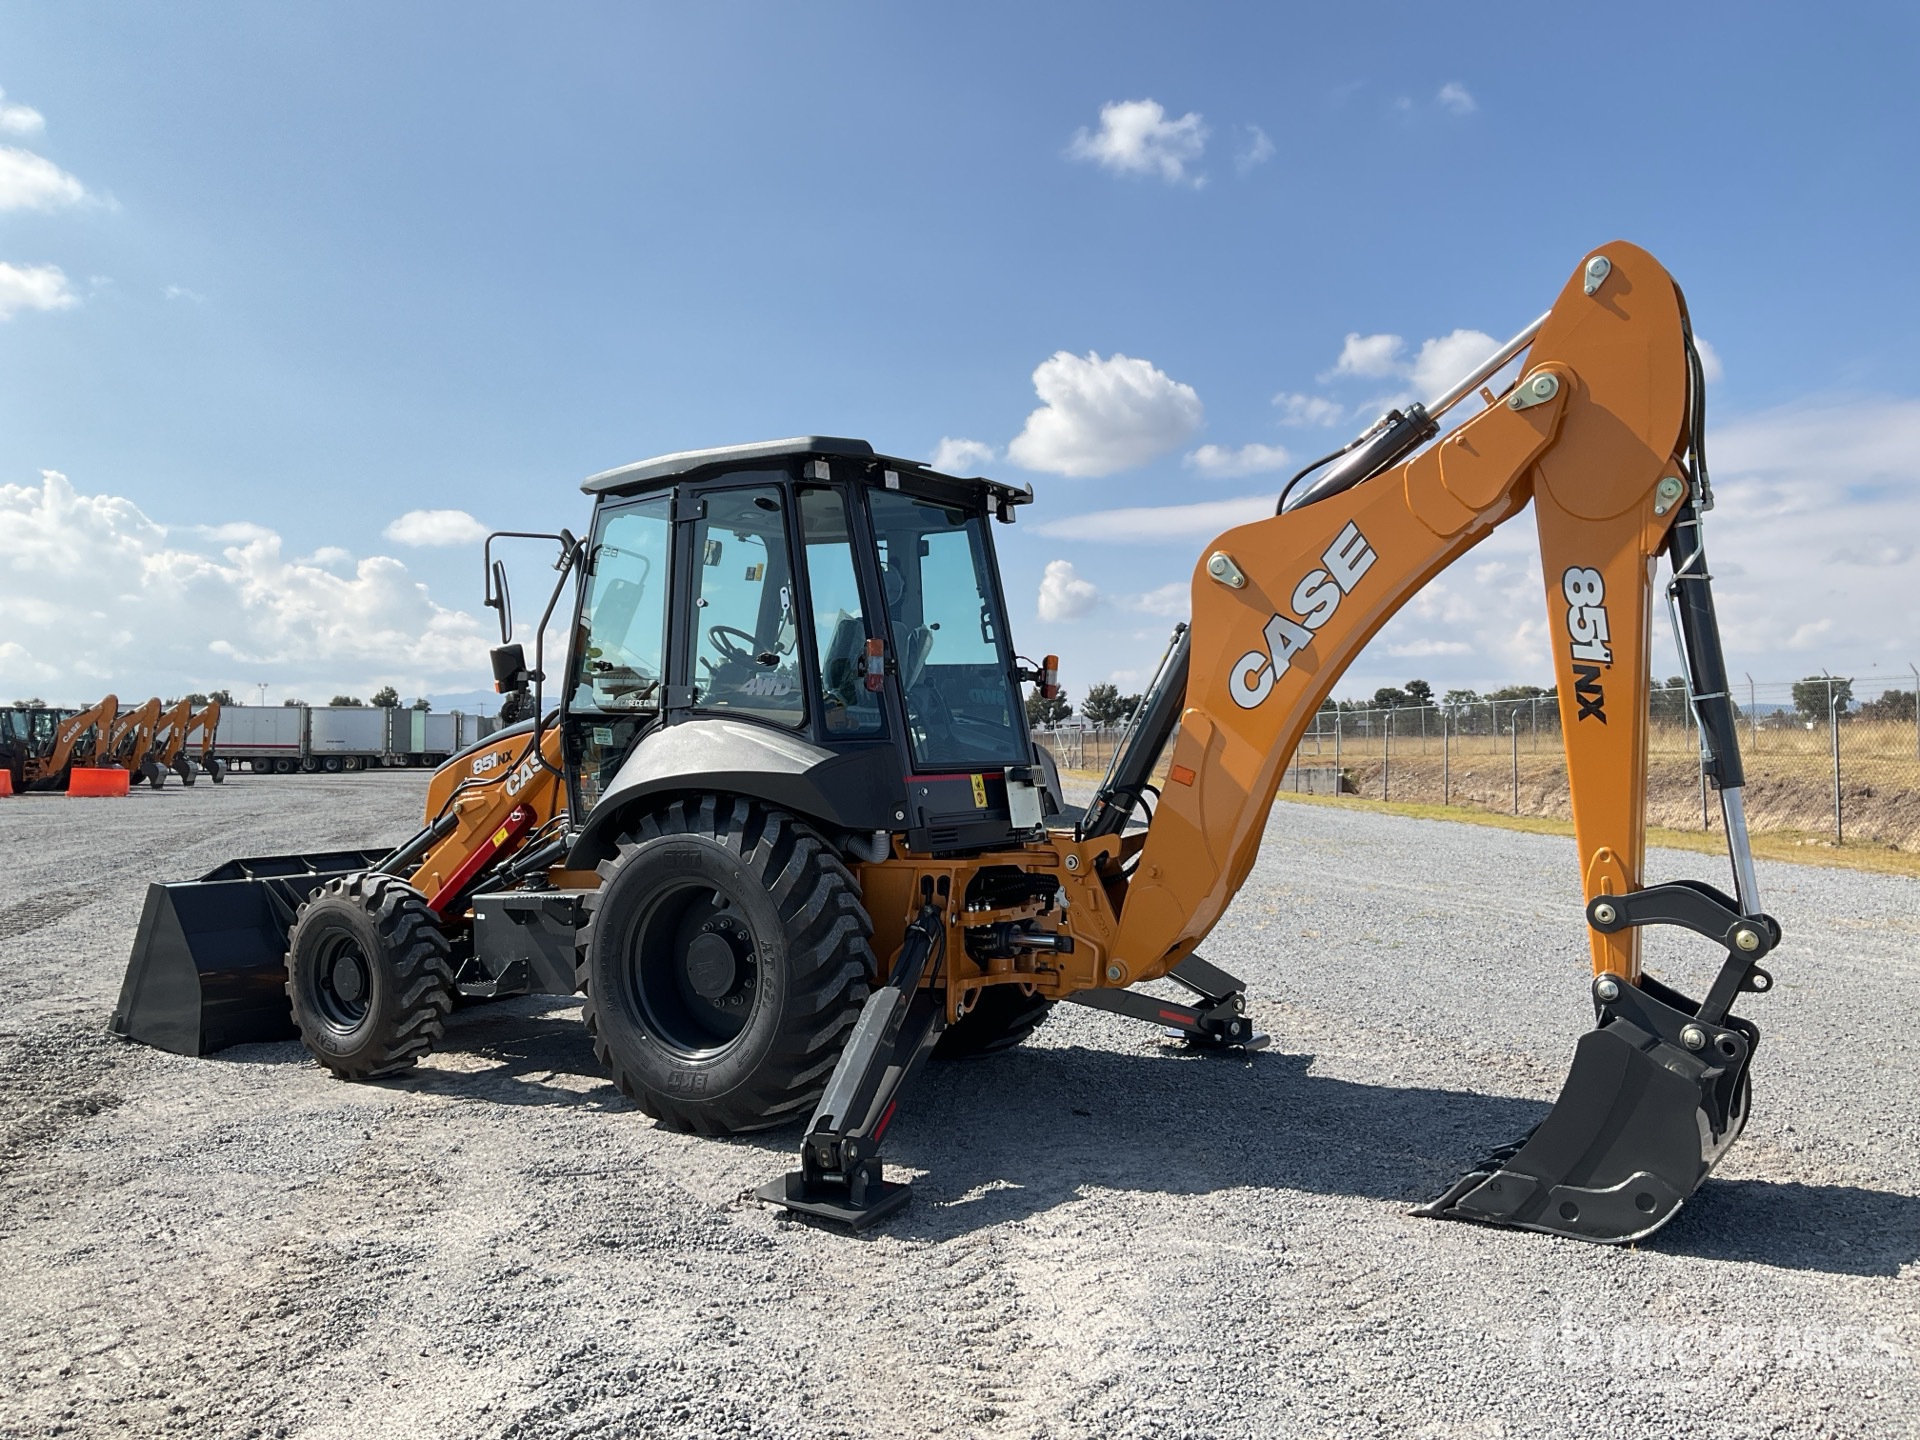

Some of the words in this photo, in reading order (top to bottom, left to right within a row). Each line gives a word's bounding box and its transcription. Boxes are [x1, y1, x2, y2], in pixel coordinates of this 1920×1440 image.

[1229, 519, 1379, 710] CASE
[740, 678, 793, 696] 4WD
[62, 721, 82, 743] CASE
[112, 721, 128, 742] ASE
[505, 749, 547, 797] CAS
[668, 1070, 709, 1095] BKT
